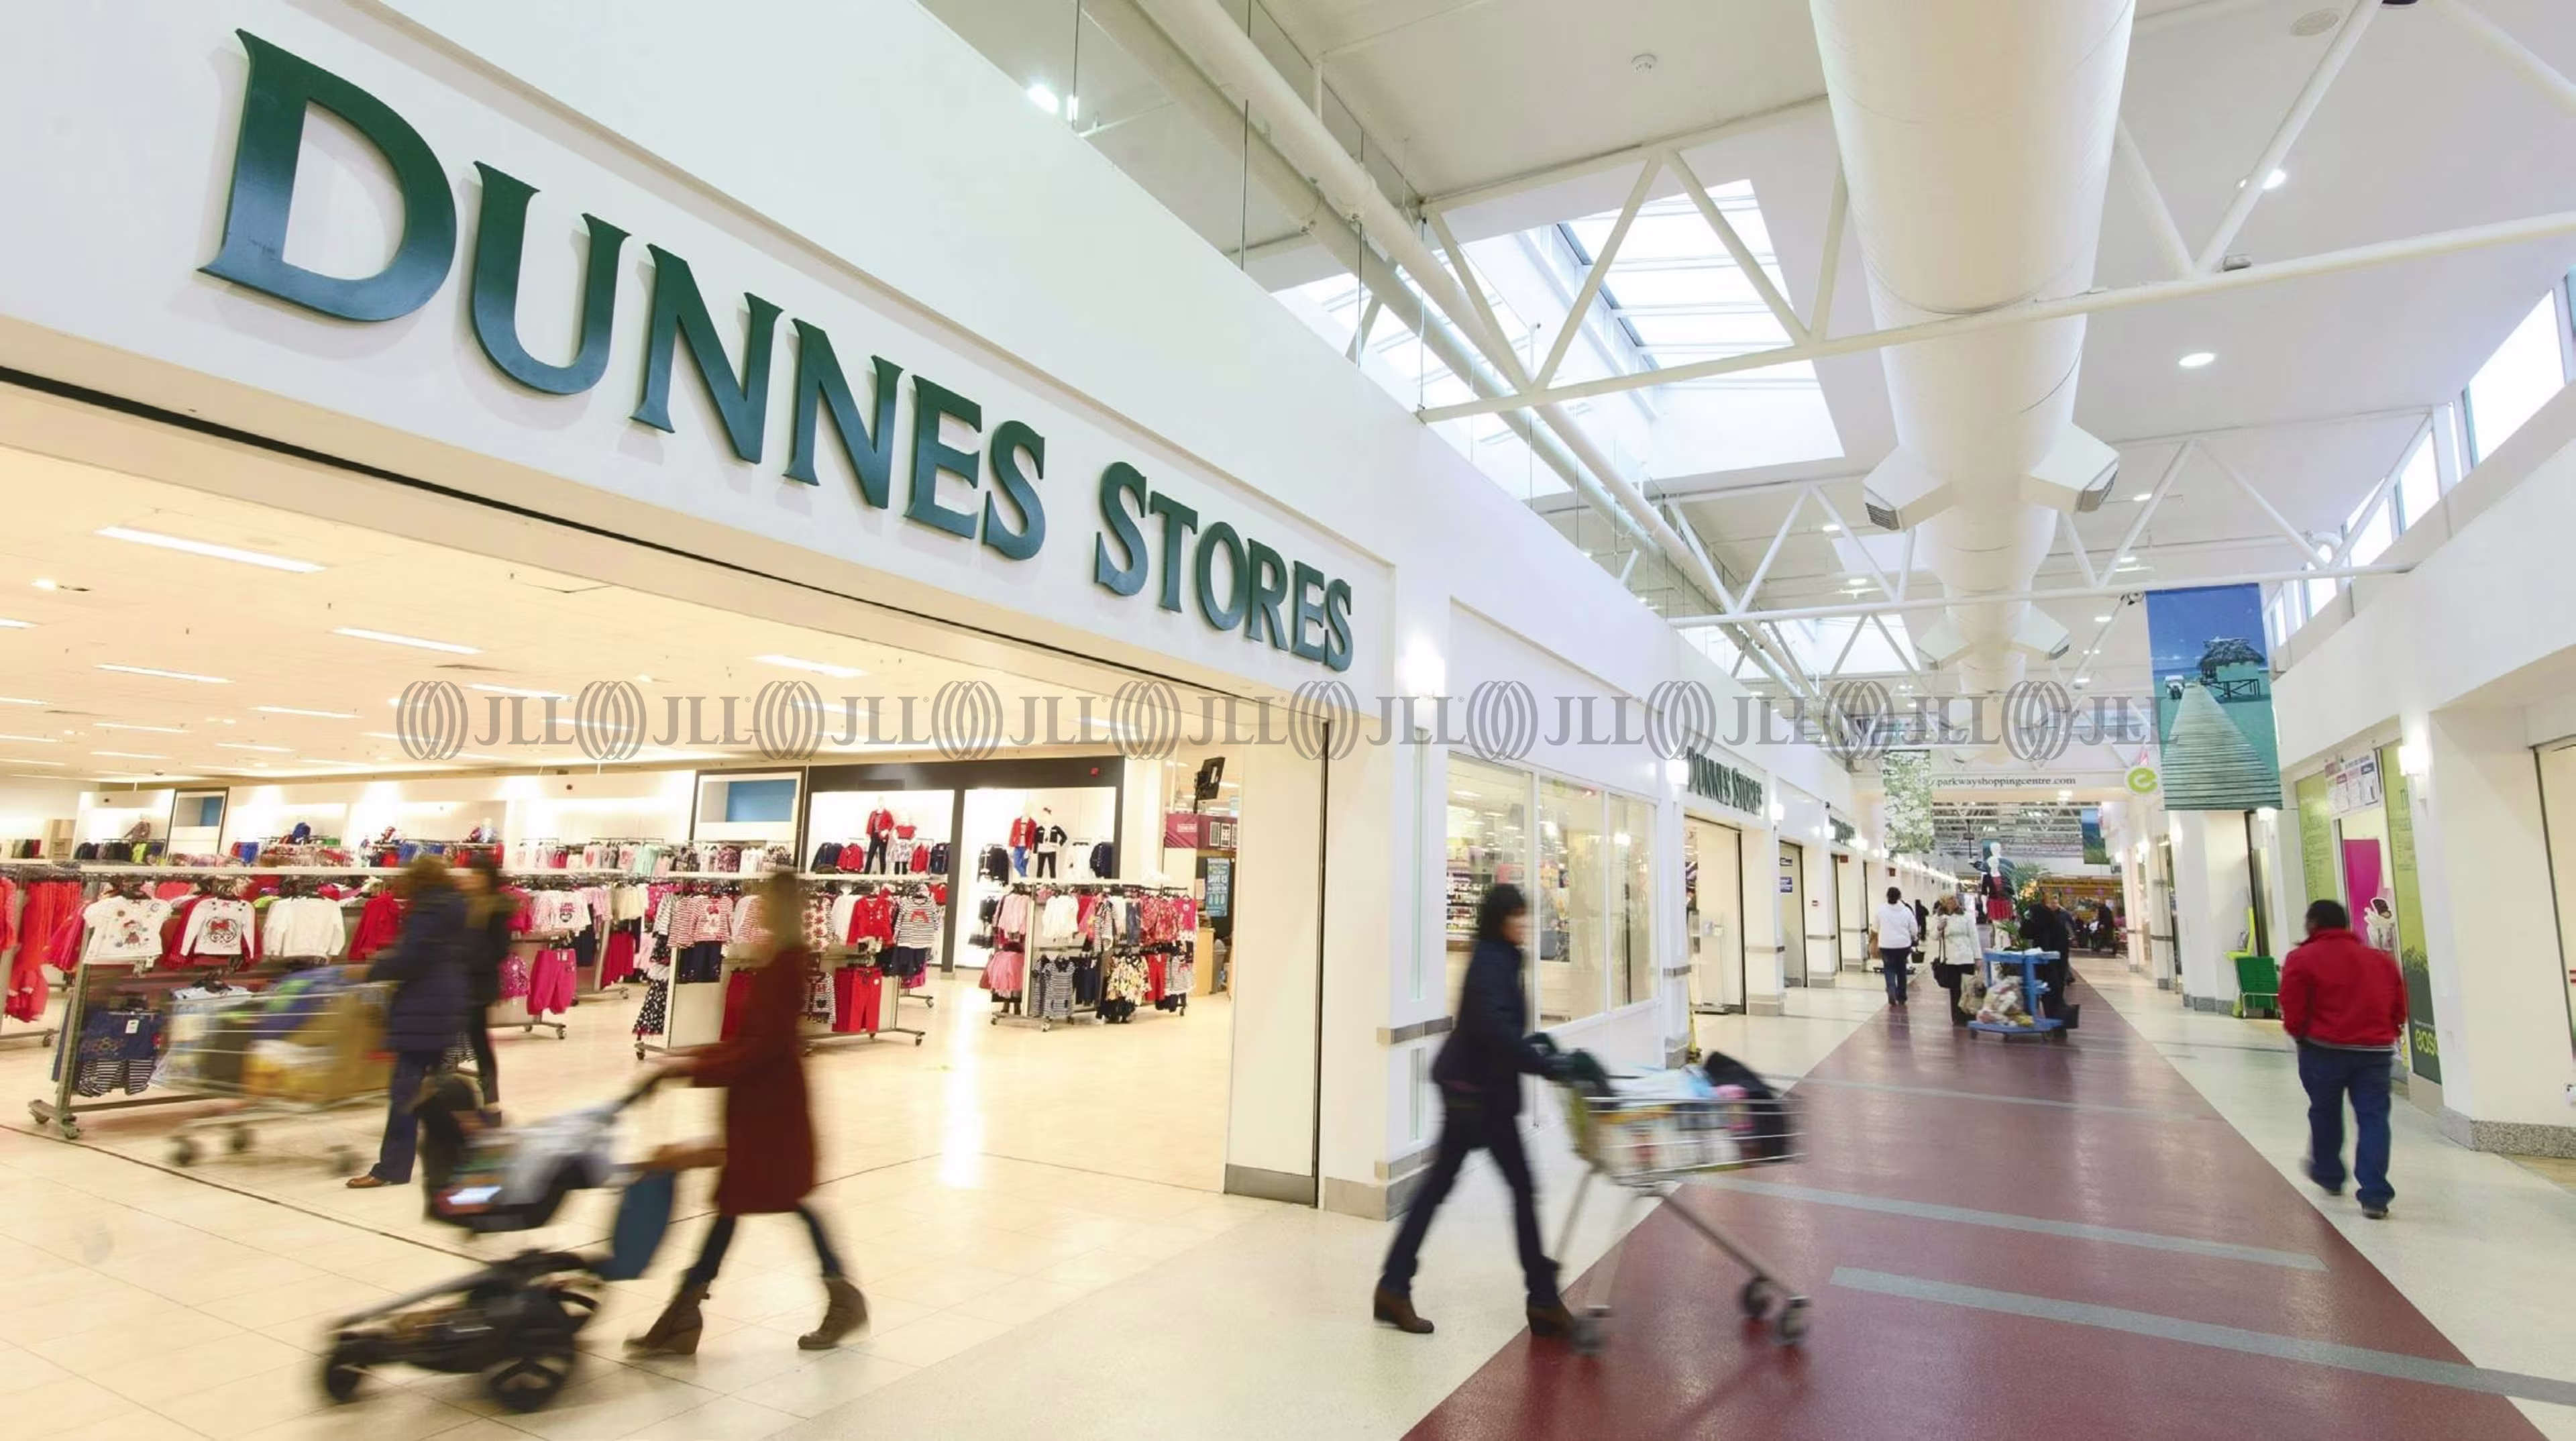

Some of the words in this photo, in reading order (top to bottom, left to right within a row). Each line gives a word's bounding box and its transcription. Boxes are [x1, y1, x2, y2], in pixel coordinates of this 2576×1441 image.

[197, 28, 1046, 562] DUNNES
[1094, 461, 1353, 672] STORES
[1686, 745, 1731, 806] DUNNES
